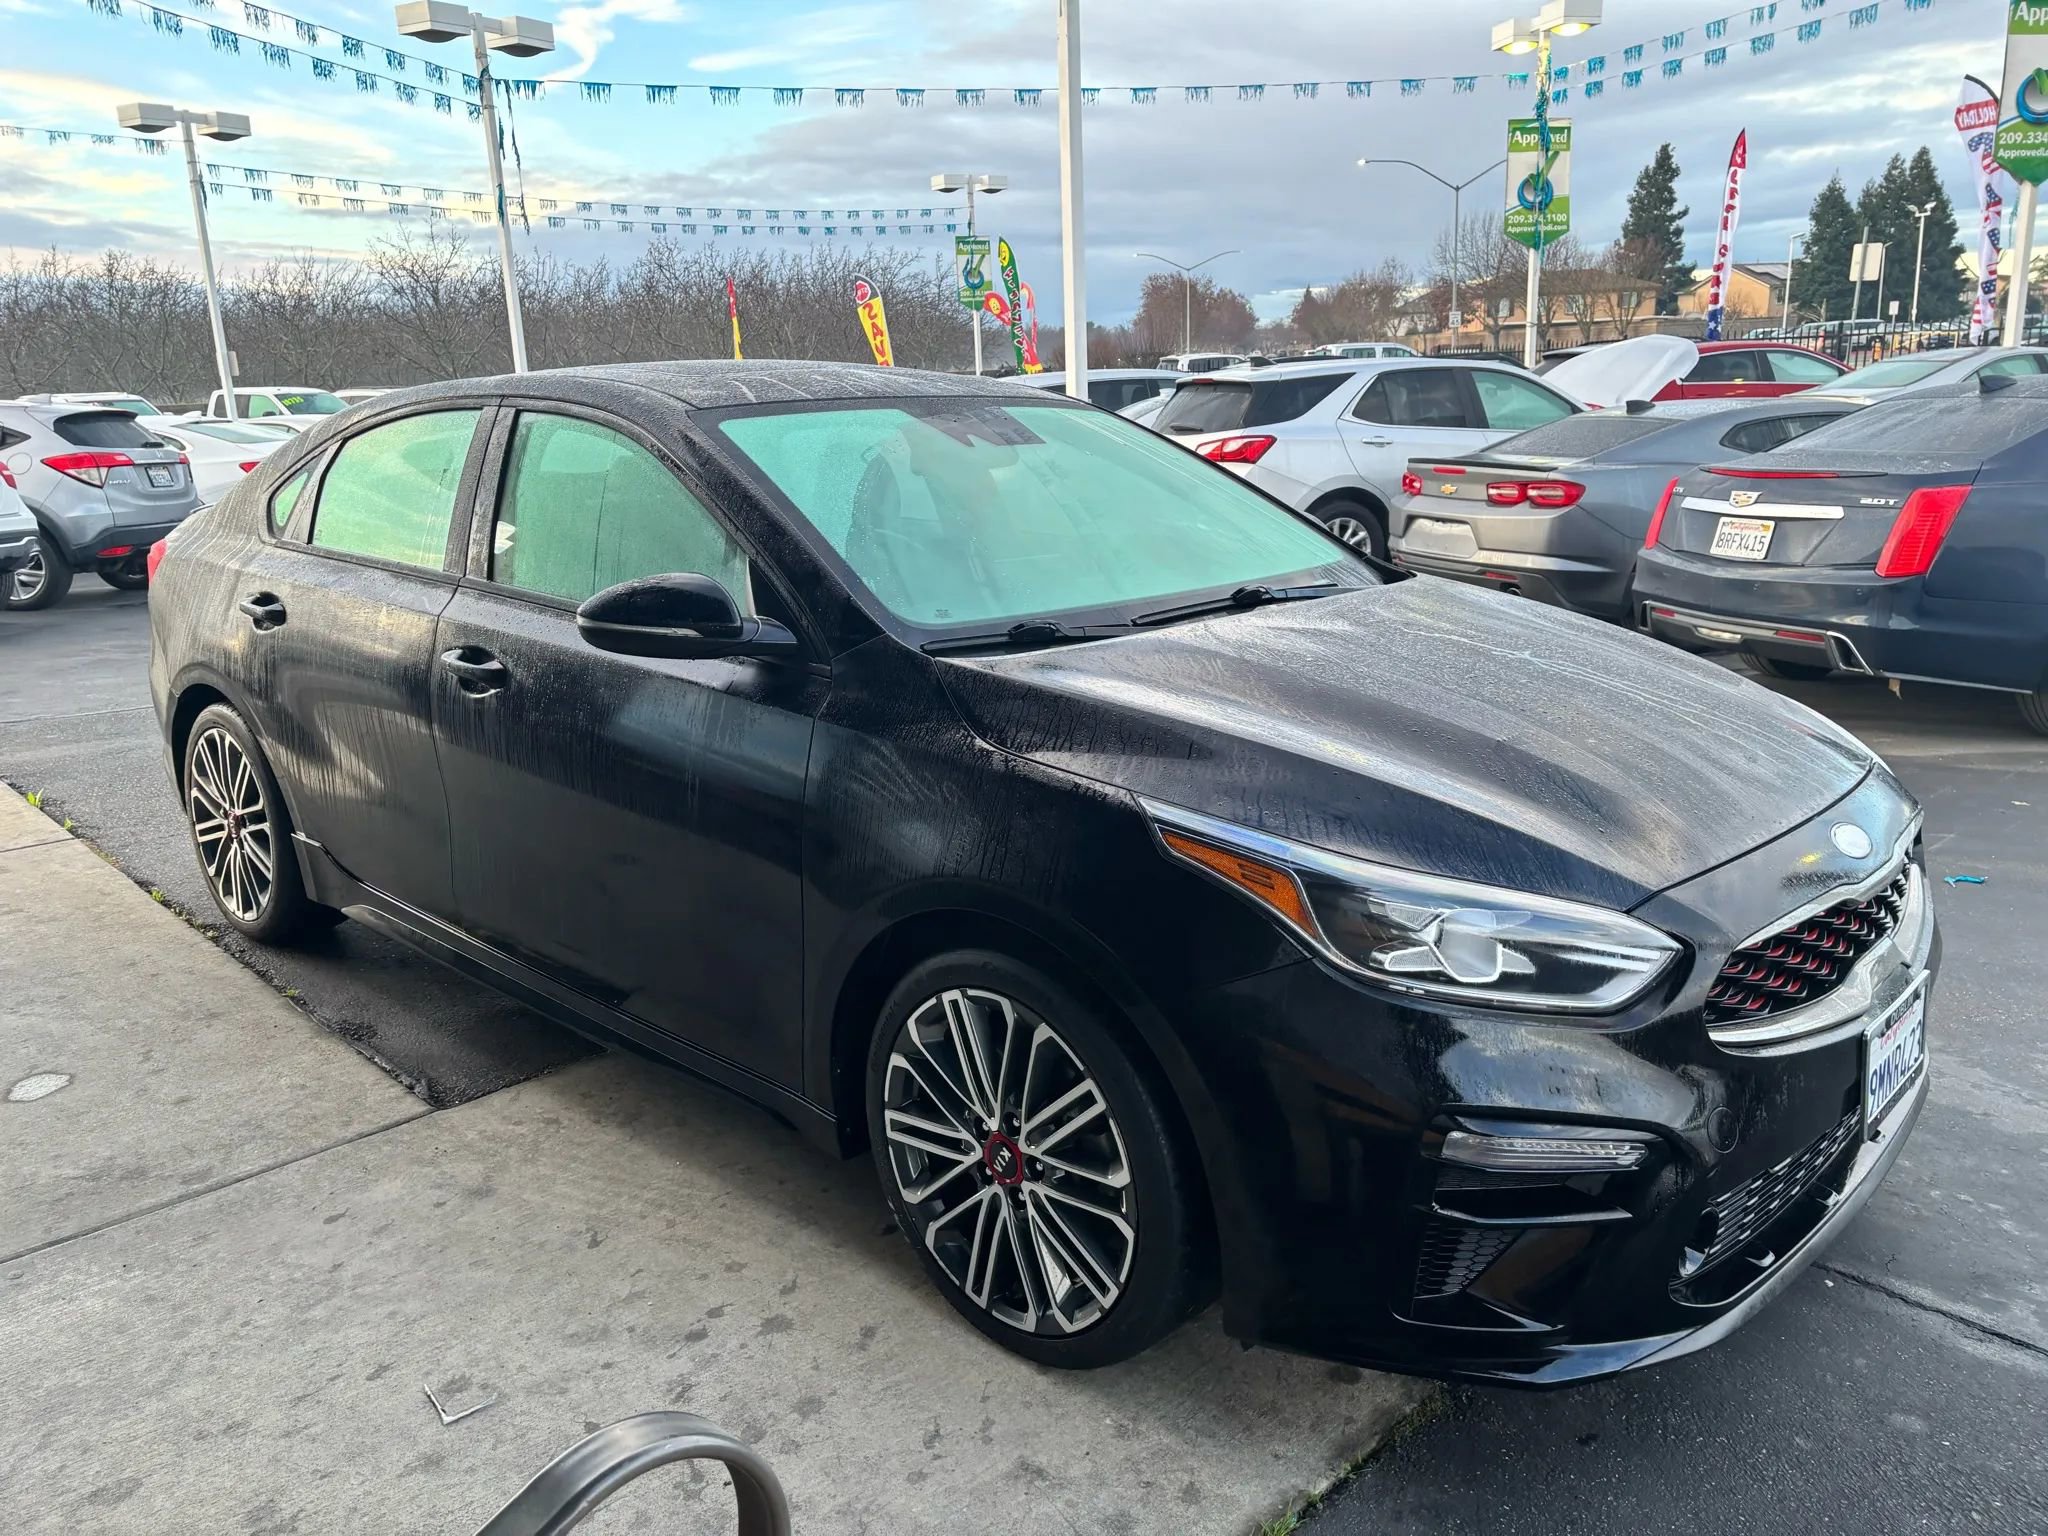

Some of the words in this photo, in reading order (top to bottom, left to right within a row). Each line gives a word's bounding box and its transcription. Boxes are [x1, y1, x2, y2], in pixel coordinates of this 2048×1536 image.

[1511, 129, 1568, 146] Appved
[1715, 532, 1767, 552] 8RFX415
[993, 1146, 1012, 1172] KIA
